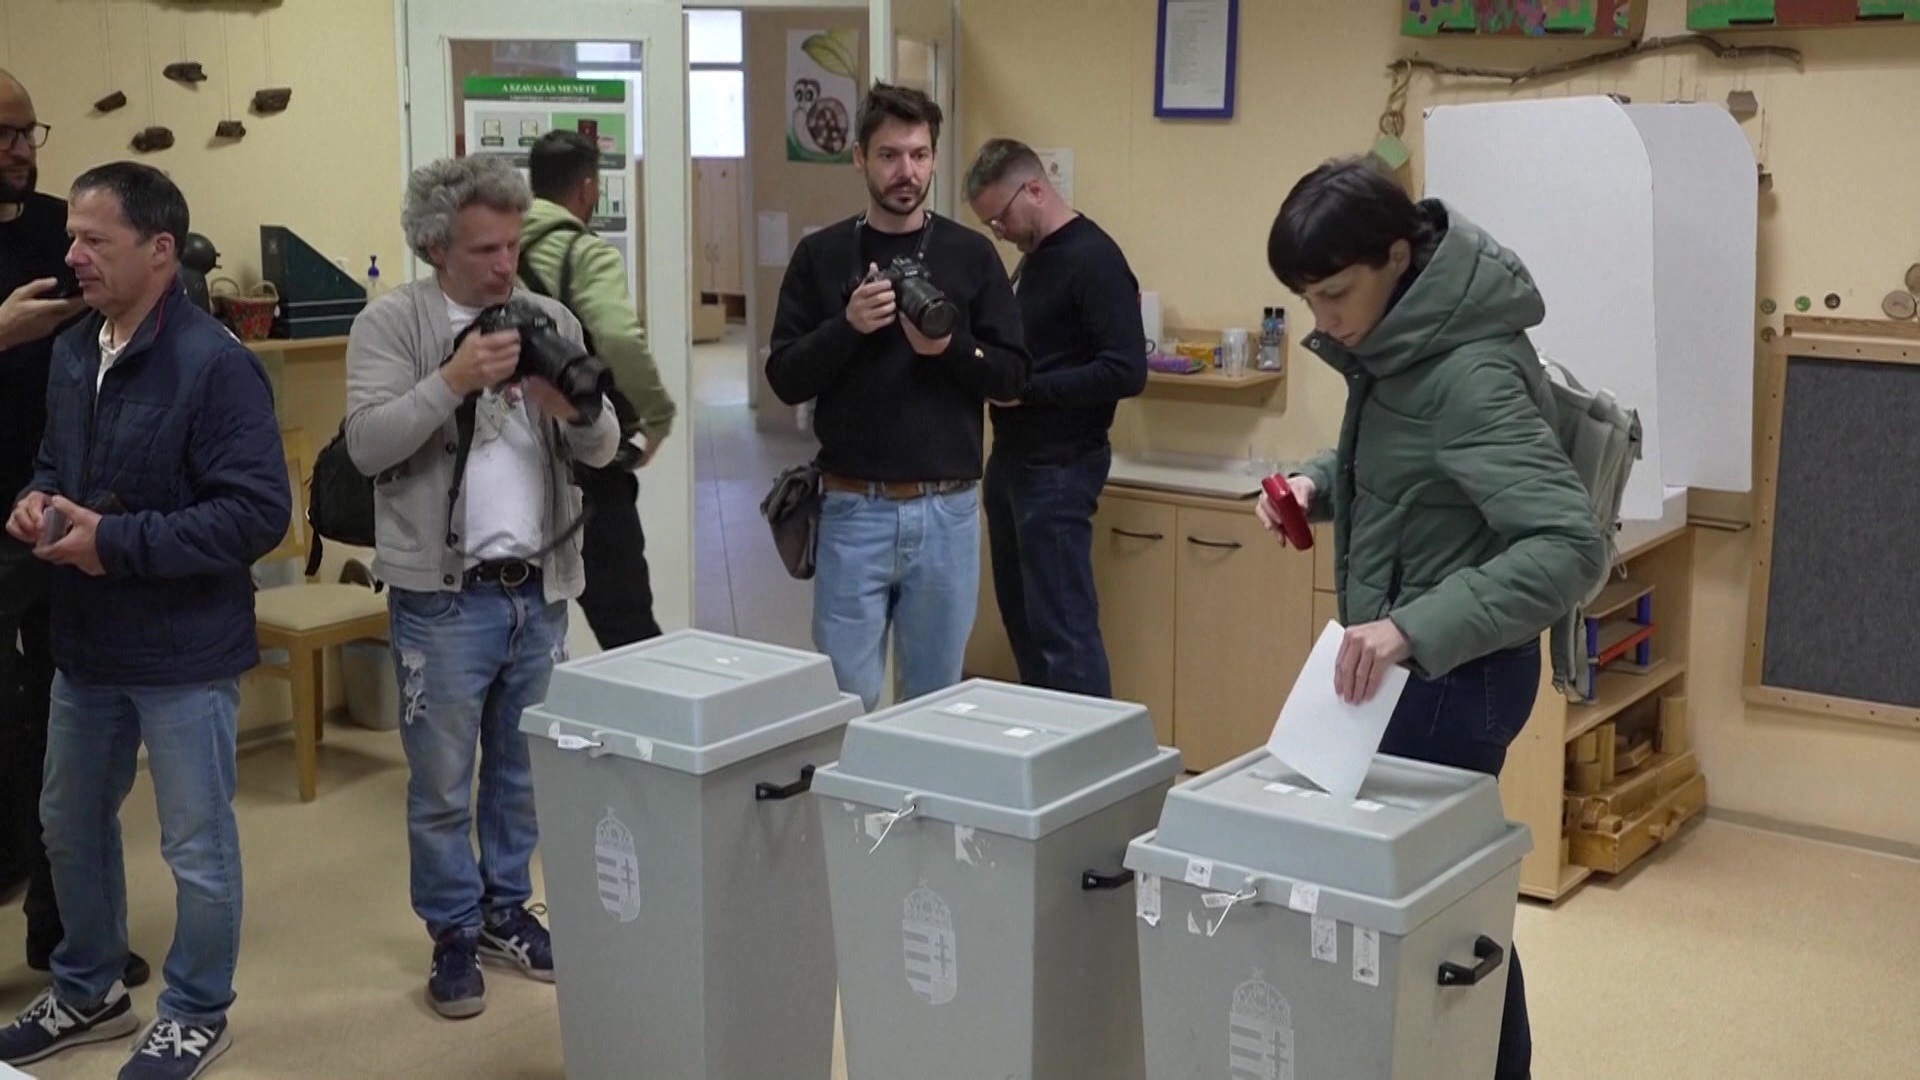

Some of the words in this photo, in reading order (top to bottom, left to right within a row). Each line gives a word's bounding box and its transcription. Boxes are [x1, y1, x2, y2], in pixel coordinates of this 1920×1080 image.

[502, 83, 509, 93] A
[510, 83, 556, 93] SZAVAZÁS
[558, 84, 597, 94] MENETE
[181, 1029, 209, 1057] N
